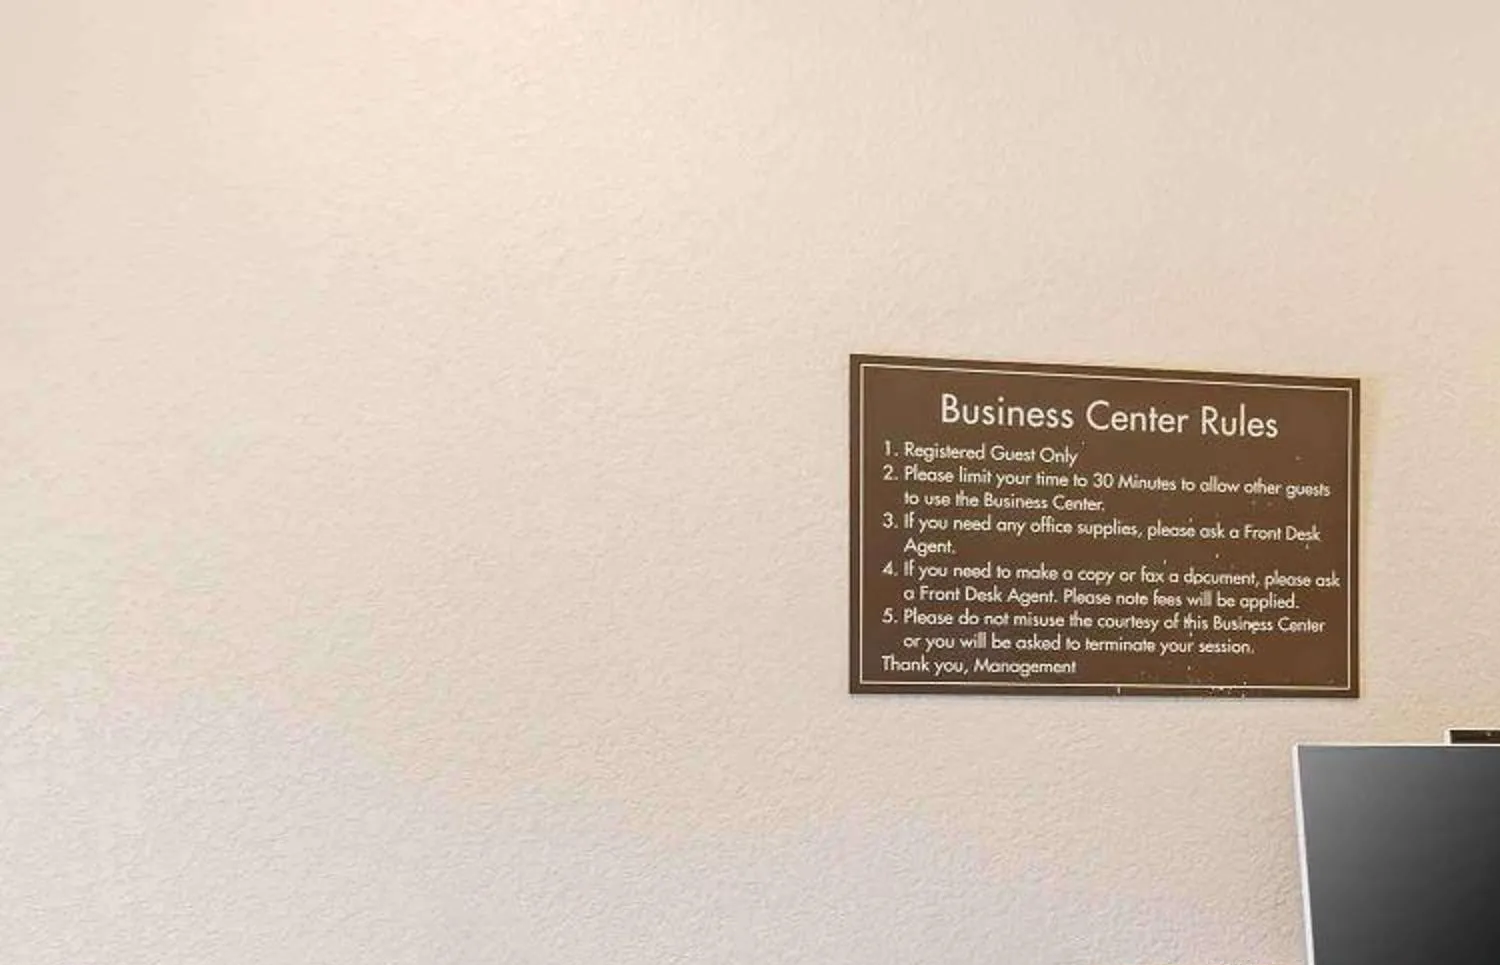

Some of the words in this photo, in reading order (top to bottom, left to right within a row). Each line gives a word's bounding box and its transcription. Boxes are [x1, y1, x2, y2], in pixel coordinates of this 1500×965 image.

[941, 393, 1075, 429] Business
[1085, 399, 1190, 433] Center
[1201, 403, 1279, 438] Rules
[885, 440, 899, 457] 1.
[904, 441, 986, 463] Registered
[990, 445, 1036, 462] Guest
[1039, 446, 1078, 468] Only
[883, 463, 899, 481] 2.
[904, 463, 955, 483] Please
[959, 465, 993, 484] limit
[995, 473, 1032, 489] your
[1036, 471, 1069, 487] time
[1073, 473, 1089, 487] to
[1093, 471, 1115, 489] 30
[1117, 474, 1177, 491] Minutes
[1181, 478, 1196, 492] to
[1199, 475, 1241, 493] allow
[1243, 477, 1282, 495] other
[1285, 483, 1331, 499] guests
[904, 491, 920, 505] to
[924, 495, 951, 507] use
[955, 489, 980, 507] the
[983, 491, 1049, 509] Business
[1051, 494, 1105, 511] Center.
[882, 511, 898, 529] 3.
[904, 511, 915, 529] If
[918, 518, 948, 534] you
[953, 514, 992, 531] need
[995, 521, 1027, 537] any
[1029, 515, 1073, 534] office
[1077, 518, 1143, 539] supplies,
[1147, 519, 1196, 541] please
[1199, 522, 1225, 539] ask
[1229, 529, 1240, 539] a
[1244, 523, 1282, 541] Front
[1285, 525, 1321, 541] Desk
[903, 537, 957, 558] Agent.
[882, 560, 899, 576] 4.
[903, 558, 915, 577] If
[918, 566, 948, 581] you
[953, 561, 992, 579] need
[996, 565, 1011, 579] to
[1015, 562, 1059, 581] make
[1062, 569, 1073, 581] a
[1077, 570, 1116, 585] copy
[1119, 571, 1137, 582] or
[1140, 565, 1165, 583] fax
[1168, 573, 1179, 583] a
[1183, 567, 1260, 588] document,
[1264, 569, 1311, 590] please
[1315, 571, 1340, 587] ask
[903, 589, 915, 601] a
[919, 585, 961, 601] Front
[965, 585, 1003, 603] Desk
[1006, 587, 1058, 607] Agent.
[1063, 587, 1112, 605] Please
[1116, 592, 1149, 606] note
[1153, 588, 1183, 607] fees
[1186, 590, 1212, 607] will
[1216, 590, 1236, 608] be
[1239, 591, 1300, 613] applied.
[882, 607, 898, 623] 5.
[903, 607, 954, 625] Please
[957, 607, 980, 625] do
[983, 613, 1009, 626] not
[1013, 611, 1065, 627] misuse
[1069, 610, 1093, 627] the
[1097, 615, 1160, 633] courtesy
[1163, 611, 1180, 630] of
[1183, 613, 1209, 631] this
[1213, 615, 1274, 635] Business
[1277, 616, 1325, 633] Center
[903, 637, 921, 648] or
[925, 637, 955, 653] you
[959, 631, 987, 649] will
[991, 631, 1012, 649] be
[1015, 633, 1061, 651] asked
[1065, 637, 1081, 651] to
[1085, 636, 1156, 652] terminate
[1159, 641, 1194, 656] your
[1199, 639, 1255, 654] session.
[881, 654, 930, 671] Thank
[933, 661, 969, 677] you,
[973, 658, 1077, 677] Management
